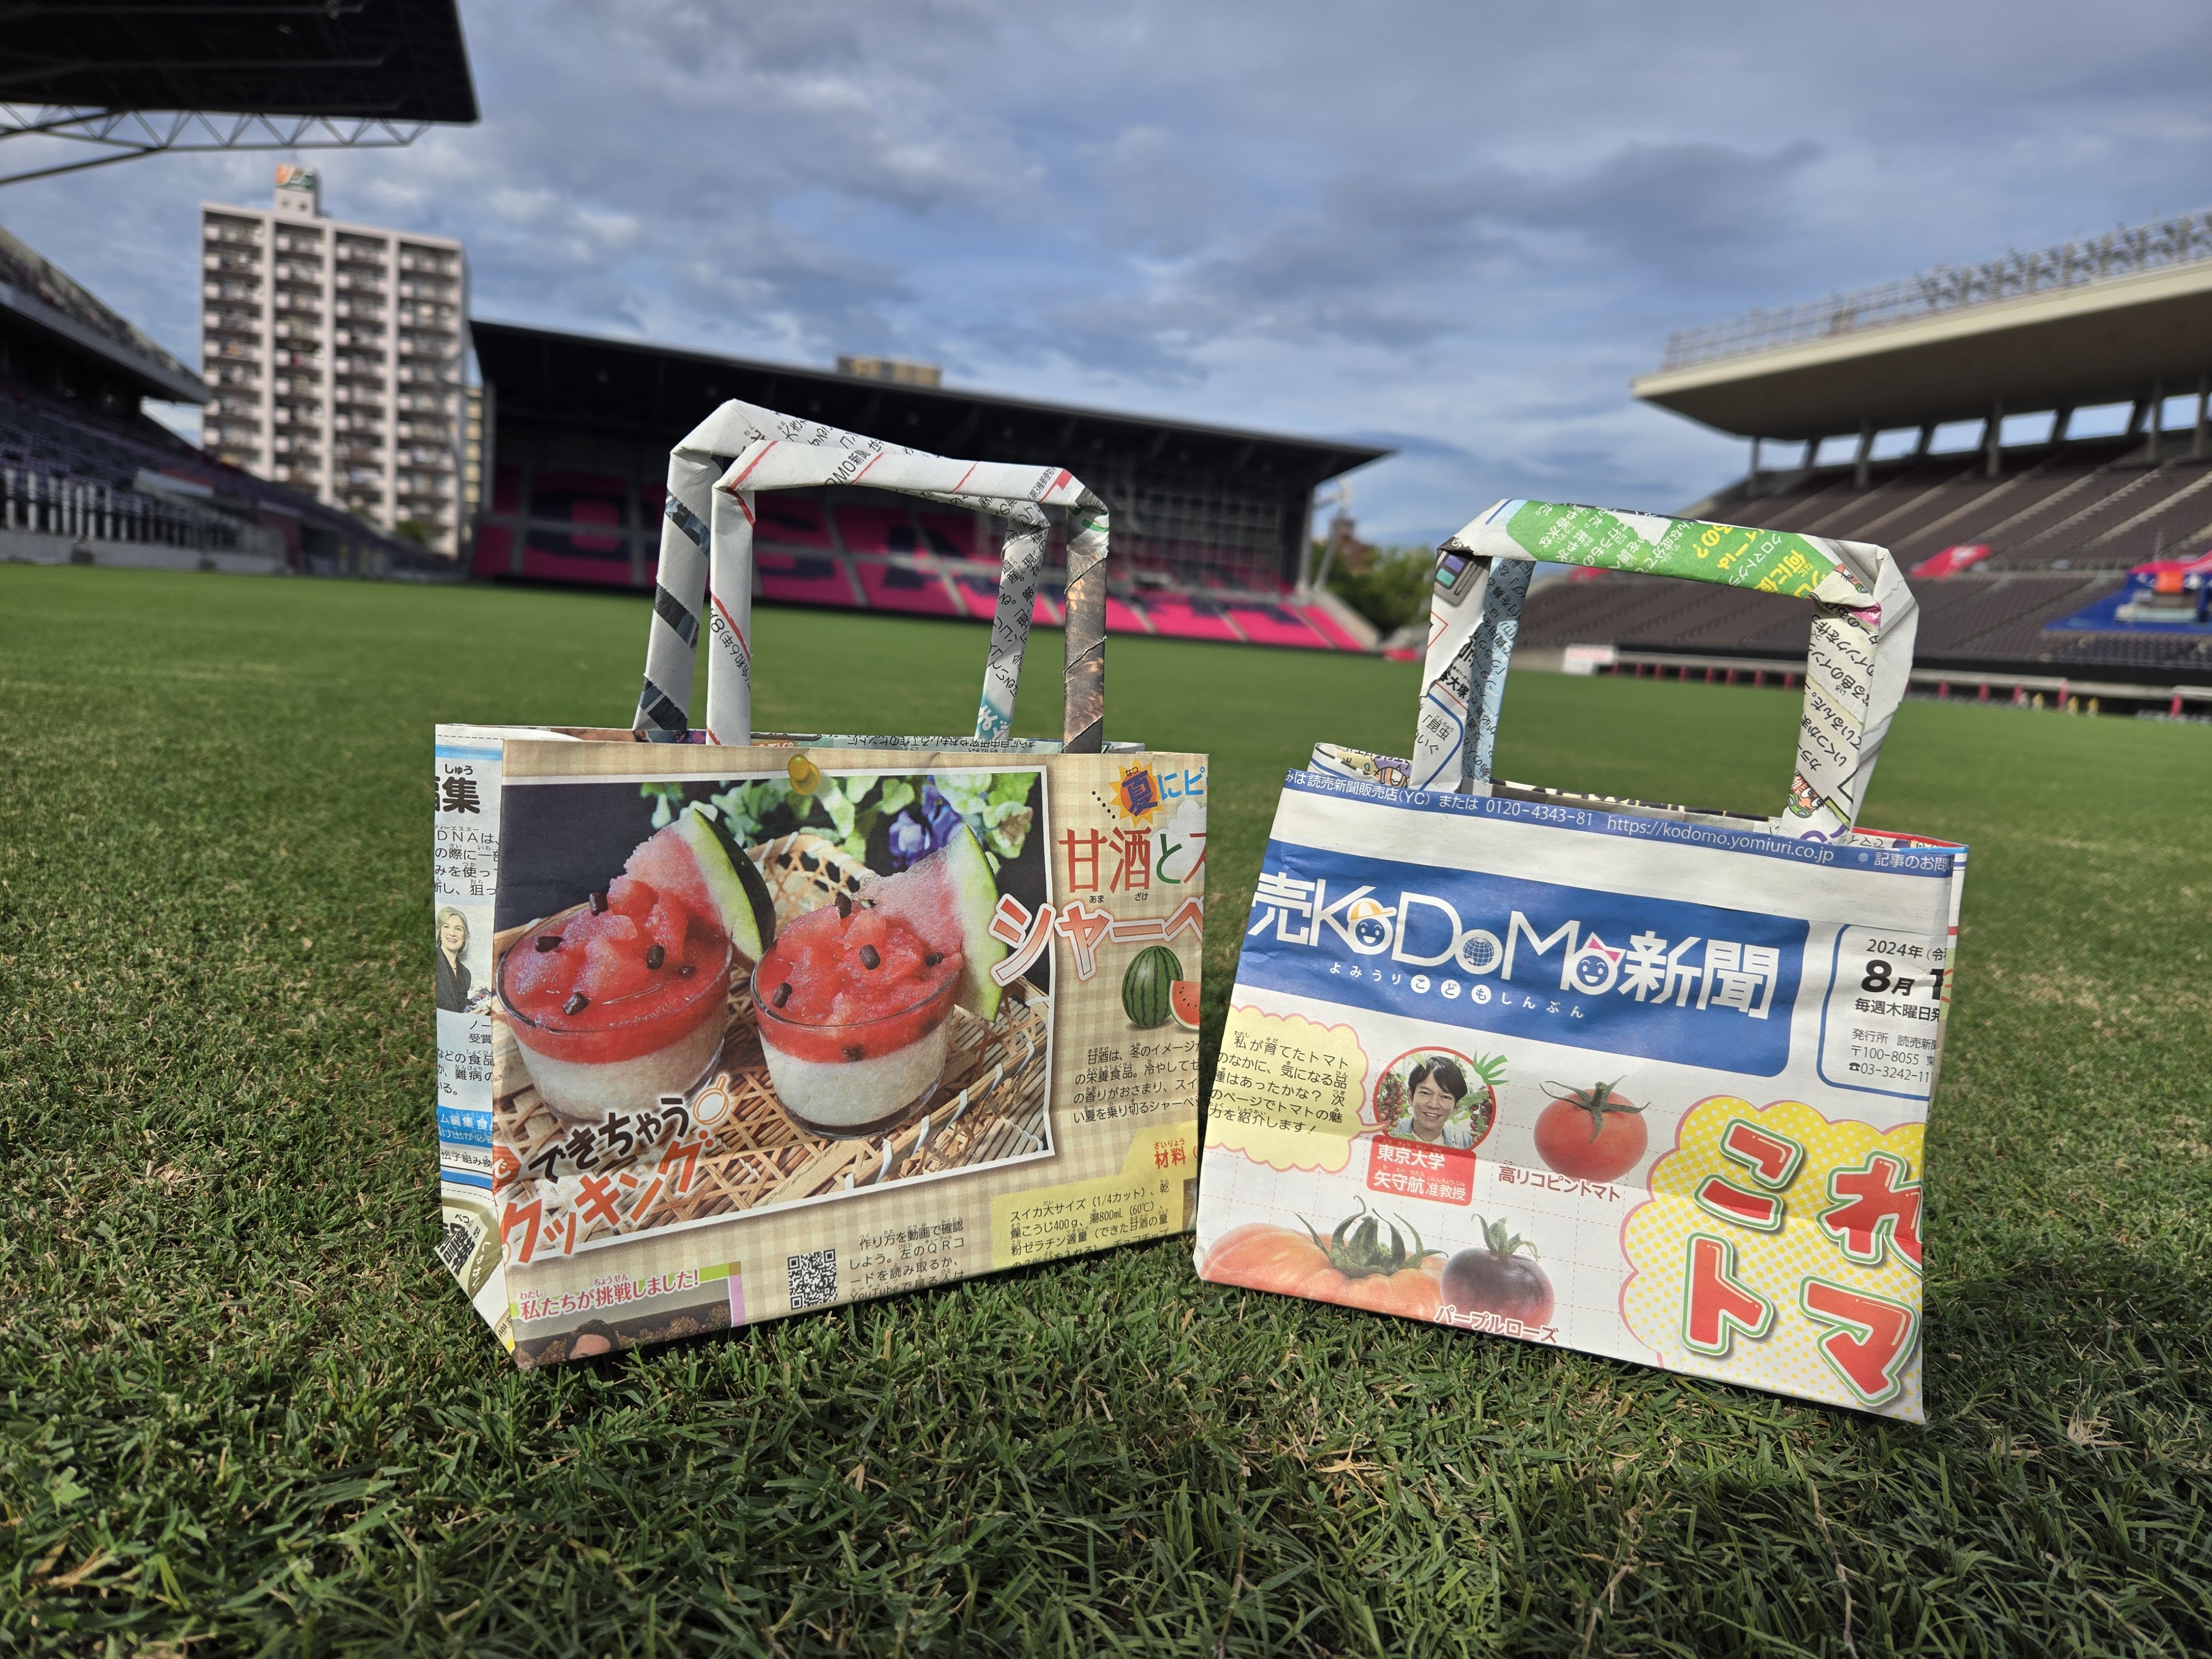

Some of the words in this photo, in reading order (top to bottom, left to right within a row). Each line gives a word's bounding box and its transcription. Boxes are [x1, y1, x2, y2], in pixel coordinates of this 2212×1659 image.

[445, 764, 473, 775] しゅう
[1125, 767, 1138, 776] なつ
[1439, 796, 1478, 810] または
[1486, 800, 1592, 826] 0120-4343-81
[1607, 816, 1834, 863] https://kodomo.yomiuri.co.jp
[469, 1034, 492, 1044] 受賞
[1234, 1036, 1348, 1070] 私が育てたトマト
[1852, 1028, 1888, 1045] 発行所
[1218, 1052, 1347, 1089] のなかに、気になる品
[1074, 1078, 1197, 1104] の香りがおさまり、スイ
[1211, 1089, 1343, 1123] のページでトマトの魅
[528, 1098, 689, 1184] できちゃう
[1376, 1144, 1445, 1170] 東京大学
[500, 1131, 714, 1263] クッキング
[1499, 1165, 1620, 1202] 高リコピントマト
[859, 1220, 963, 1250] 作り方を動画で確認
[520, 1290, 543, 1300] わたし
[594, 1274, 628, 1285] ちょうせん
[1434, 1306, 1558, 1343] パープルローズ
[1682, 1233, 1918, 1406] トマ
